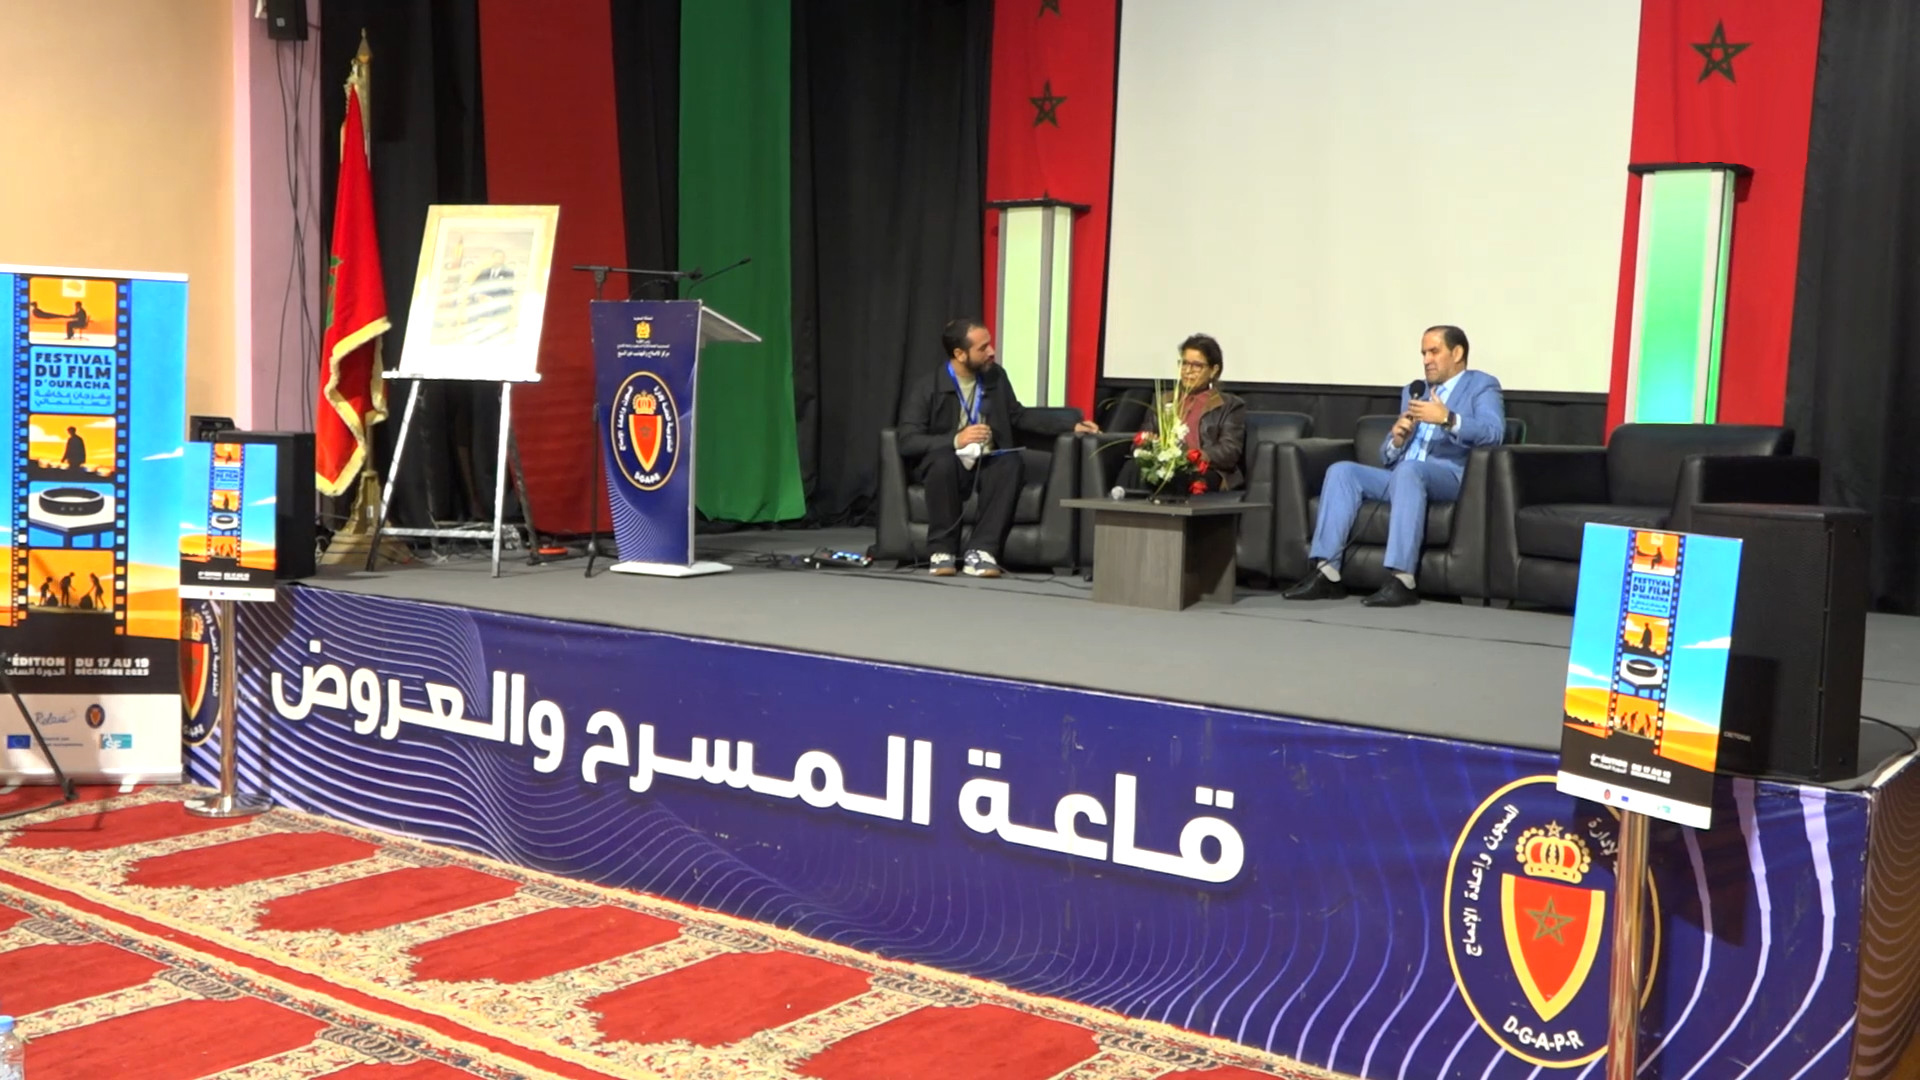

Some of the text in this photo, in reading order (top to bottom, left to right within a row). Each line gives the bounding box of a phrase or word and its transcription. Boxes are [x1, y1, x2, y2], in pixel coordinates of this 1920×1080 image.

[34, 352, 112, 366] FESTIVAL
[35, 364, 111, 380] DU FILM
[34, 379, 111, 390] D'OUKACHA
[1633, 584, 1671, 597] DU FILM
[12, 653, 66, 667] ÉDITION
[75, 657, 94, 667] DU
[97, 657, 111, 667] 17
[112, 657, 132, 668] AU
[270, 639, 1245, 883] قاعة المسرح والعروض
[1484, 804, 1519, 851] السجون
